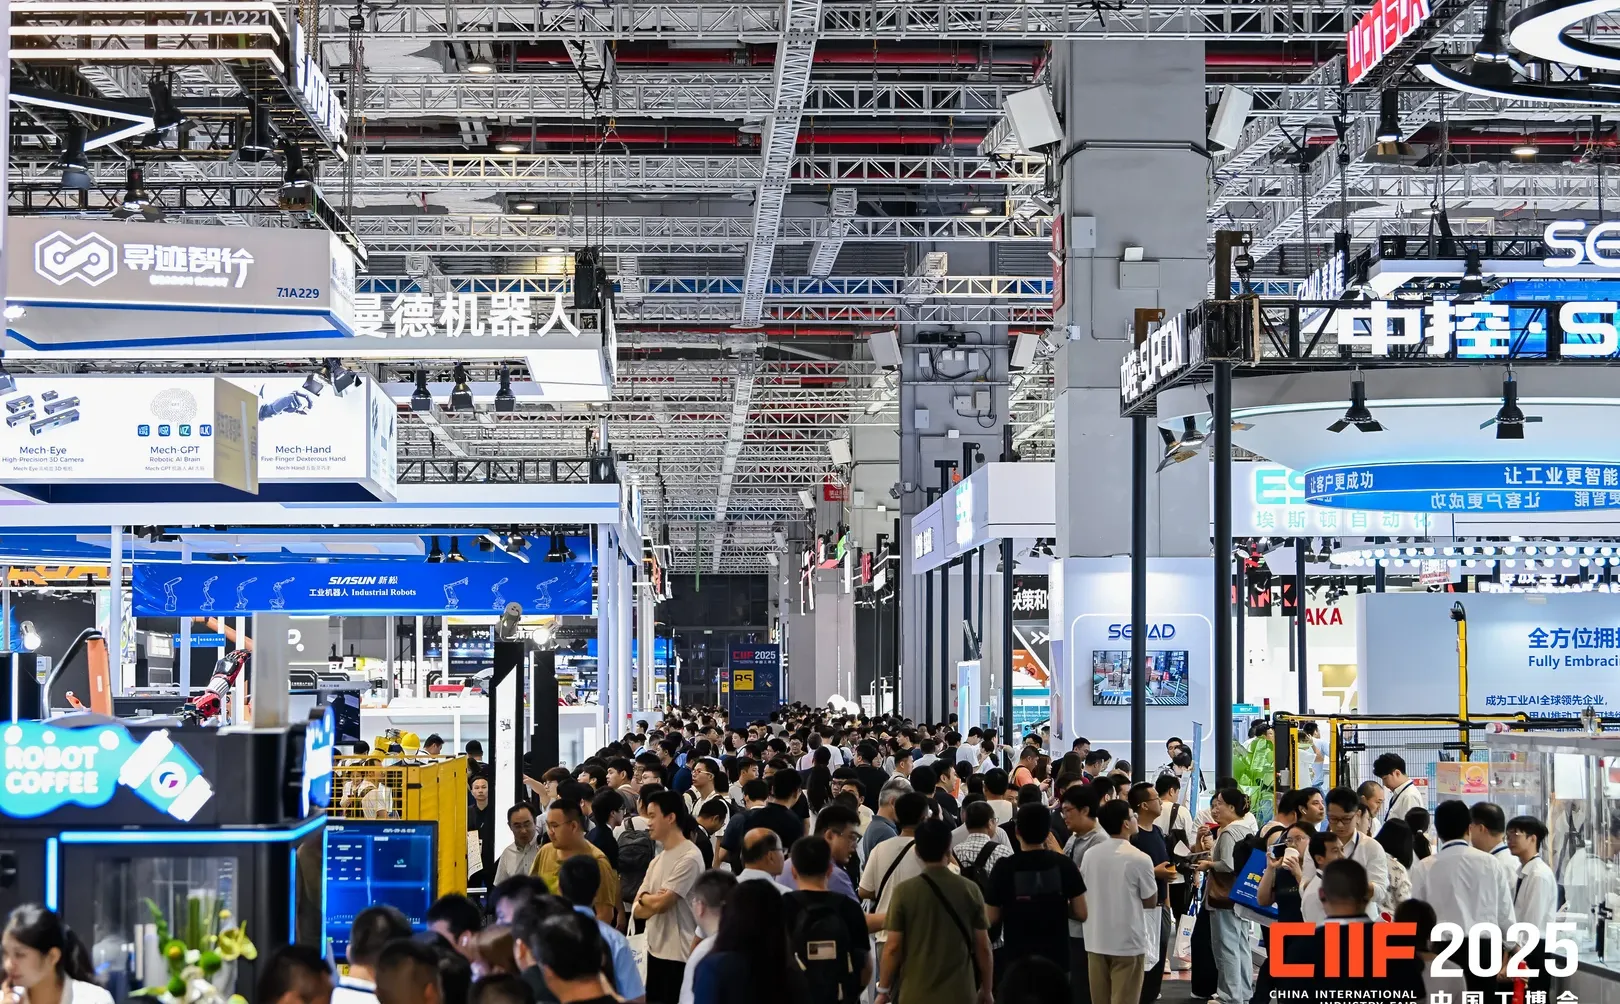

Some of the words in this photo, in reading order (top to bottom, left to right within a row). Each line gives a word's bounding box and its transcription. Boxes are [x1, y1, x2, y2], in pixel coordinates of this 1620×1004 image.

[187, 10, 270, 27] 7.1-A221
[123, 243, 255, 288] 寻迹智行
[354, 291, 581, 339] 曼德机器人
[19, 446, 67, 456] Mech-Eye
[150, 446, 200, 454] Mech-GPT
[275, 445, 332, 453] Mech-Hand
[1310, 470, 1374, 495] 让客户更成功
[1504, 466, 1619, 486] 让工业更智能
[1256, 510, 1432, 529] 埃斯顿自动化
[328, 576, 377, 585] SIASUN
[378, 576, 398, 585] 新松
[309, 588, 349, 597] 工业机器人
[351, 588, 389, 596] Industrial
[390, 588, 417, 596] Robots
[1108, 623, 1176, 640] SEAD
[1528, 627, 1620, 649] 全方位拥
[755, 650, 776, 660] 2025
[1528, 655, 1561, 670] Fully
[1564, 655, 1620, 667] Embraci
[734, 674, 753, 682] RS
[5, 745, 98, 770] ROBOT
[5, 771, 99, 794] COFFEE
